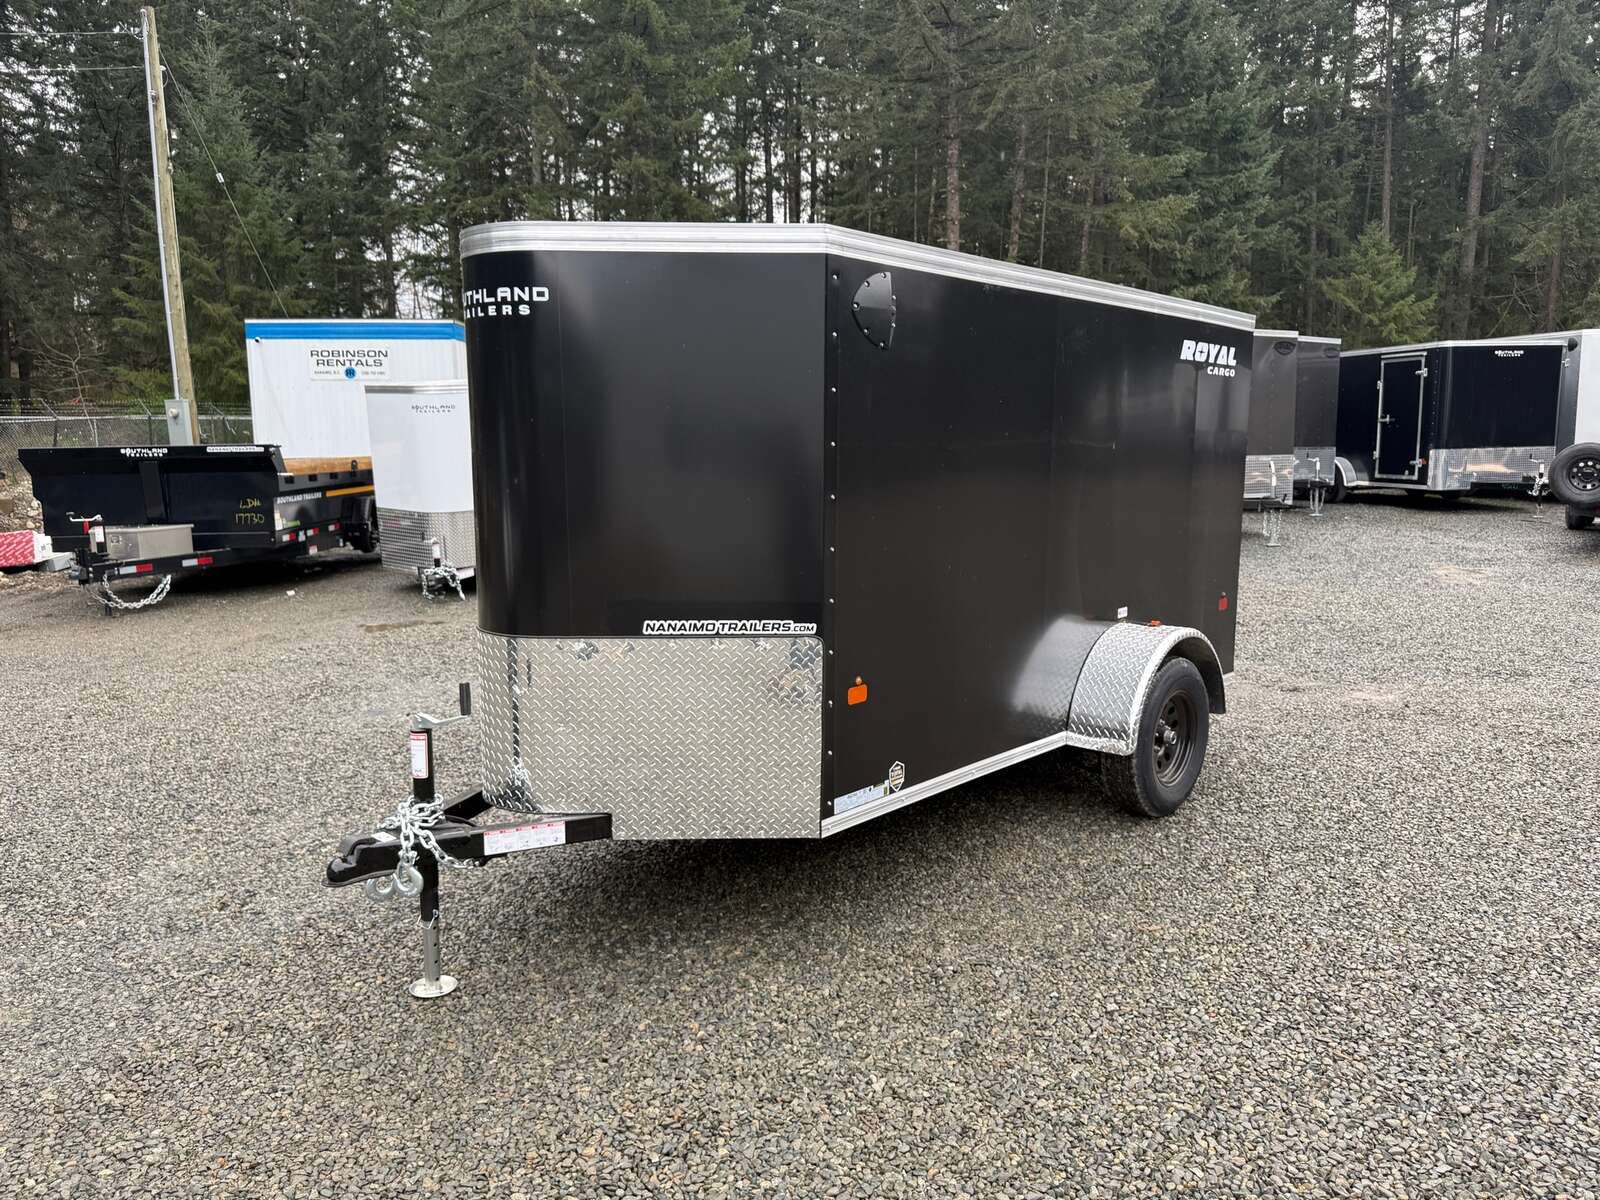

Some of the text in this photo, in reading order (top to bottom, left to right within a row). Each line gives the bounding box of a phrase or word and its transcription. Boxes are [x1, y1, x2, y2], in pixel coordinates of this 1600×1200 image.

[310, 349, 388, 358] ROBINSON
[1180, 339, 1237, 366] ROYAL
[316, 359, 383, 367] RENTALS
[1207, 366, 1236, 377] CARGO
